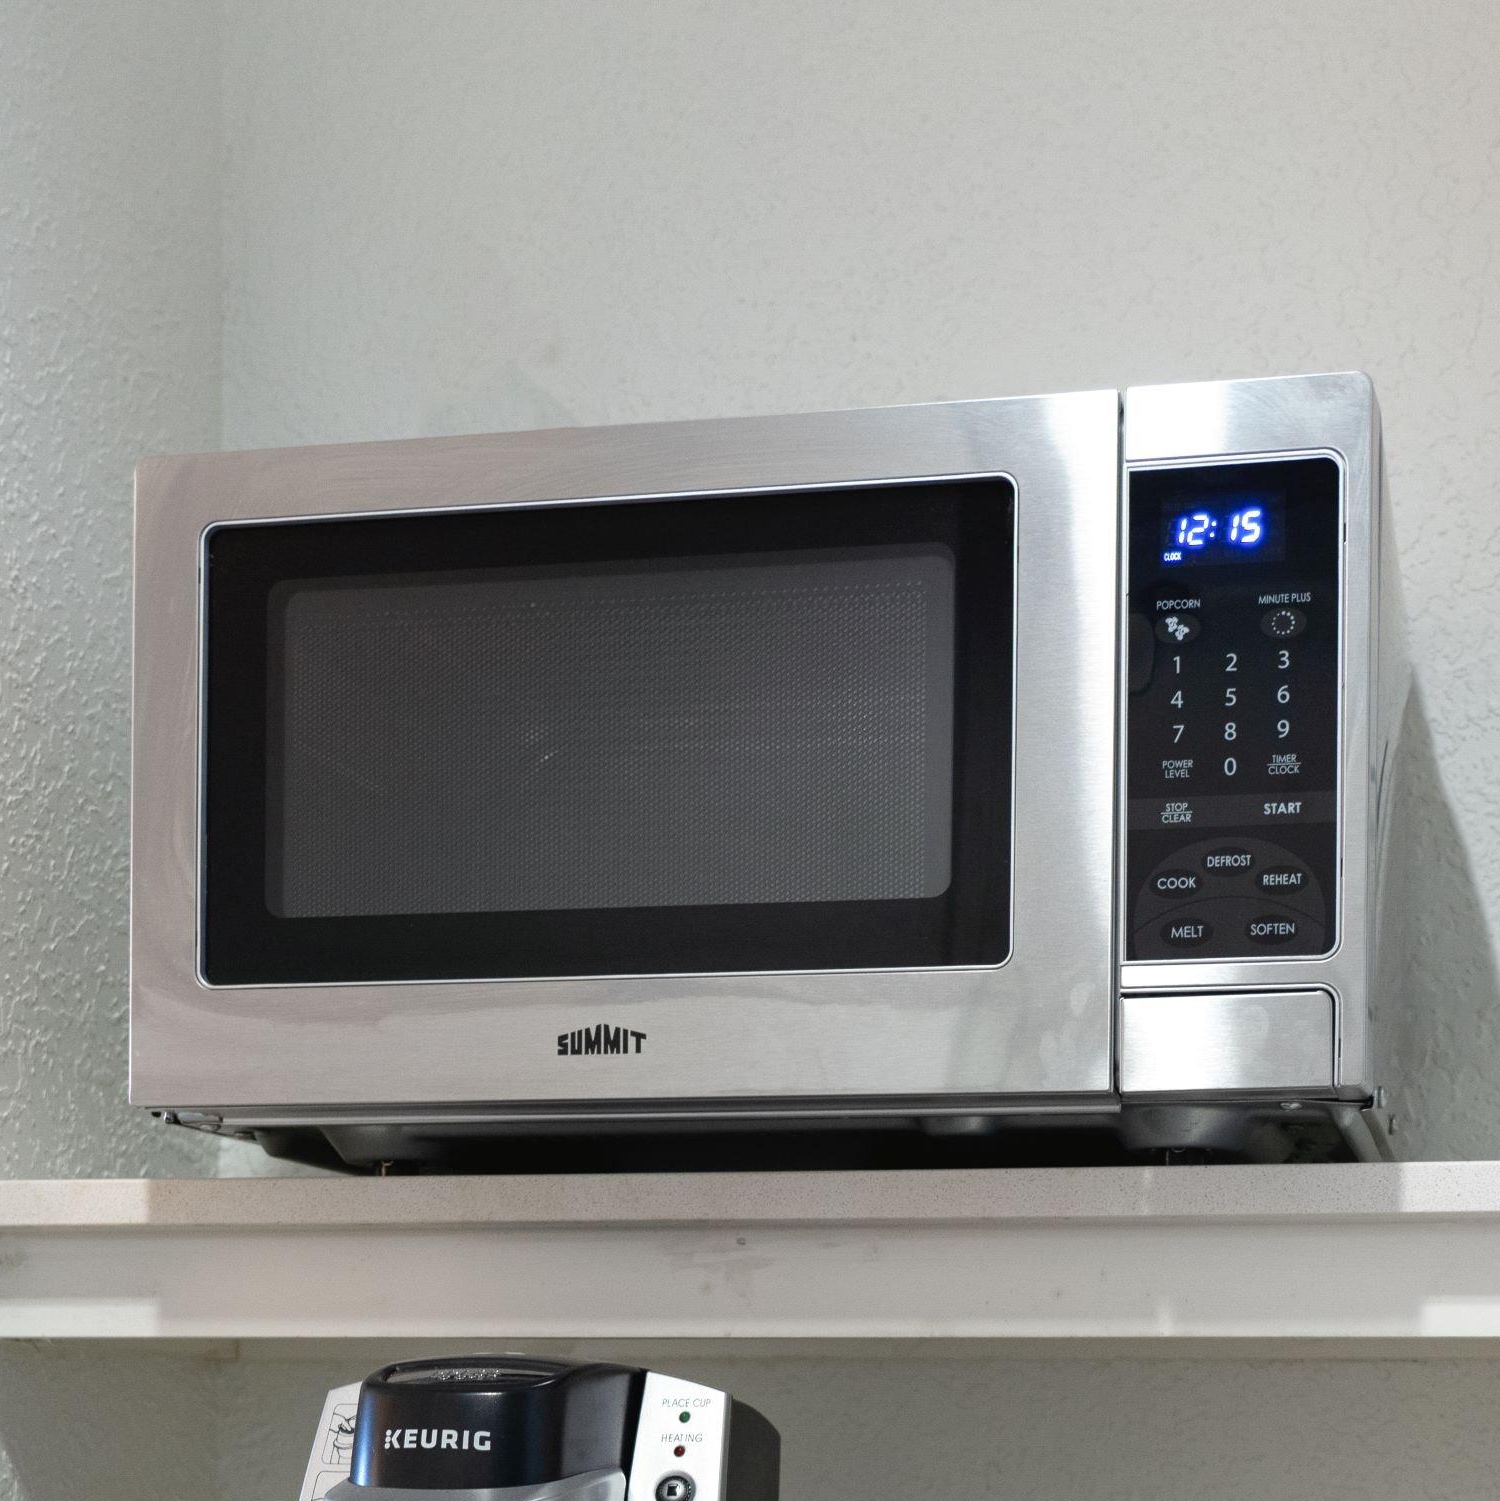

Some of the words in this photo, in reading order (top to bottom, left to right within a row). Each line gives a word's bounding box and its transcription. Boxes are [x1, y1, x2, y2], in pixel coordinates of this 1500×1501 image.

[1176, 508, 1263, 546] 12:15
[1163, 551, 1182, 562] CLOCK
[1156, 599, 1201, 611] POPCORN
[1258, 594, 1290, 605] MINUTE
[1291, 592, 1312, 603] PLUS
[1173, 656, 1181, 674] 1
[1225, 653, 1238, 672] 2
[1277, 650, 1290, 669] 3
[1170, 690, 1184, 709] 4
[1224, 687, 1237, 706] 5
[1276, 685, 1290, 704] 6
[1172, 724, 1185, 743] 7
[1224, 722, 1237, 741] 8
[1276, 719, 1290, 739] 9
[1162, 759, 1194, 769] POWER
[1271, 753, 1297, 764] TIMER
[1223, 757, 1237, 776] 0
[1268, 765, 1300, 775] CLOCK
[1164, 768, 1190, 779] LEVEL
[1165, 802, 1188, 813] STOP
[1263, 801, 1302, 815] START
[1162, 813, 1192, 823] CLEAR
[1206, 855, 1252, 868] DEFROST
[1157, 877, 1197, 890] COOK
[1262, 873, 1302, 886] REHEAT
[1170, 925, 1204, 938] MELT
[1250, 923, 1296, 936] SOFTEN
[557, 1023, 647, 1056] SUMMIT
[661, 1398, 690, 1408] PLACE
[692, 1398, 712, 1408] CUP
[384, 1428, 492, 1451] KEURIG
[660, 1433, 703, 1443] HEATING
